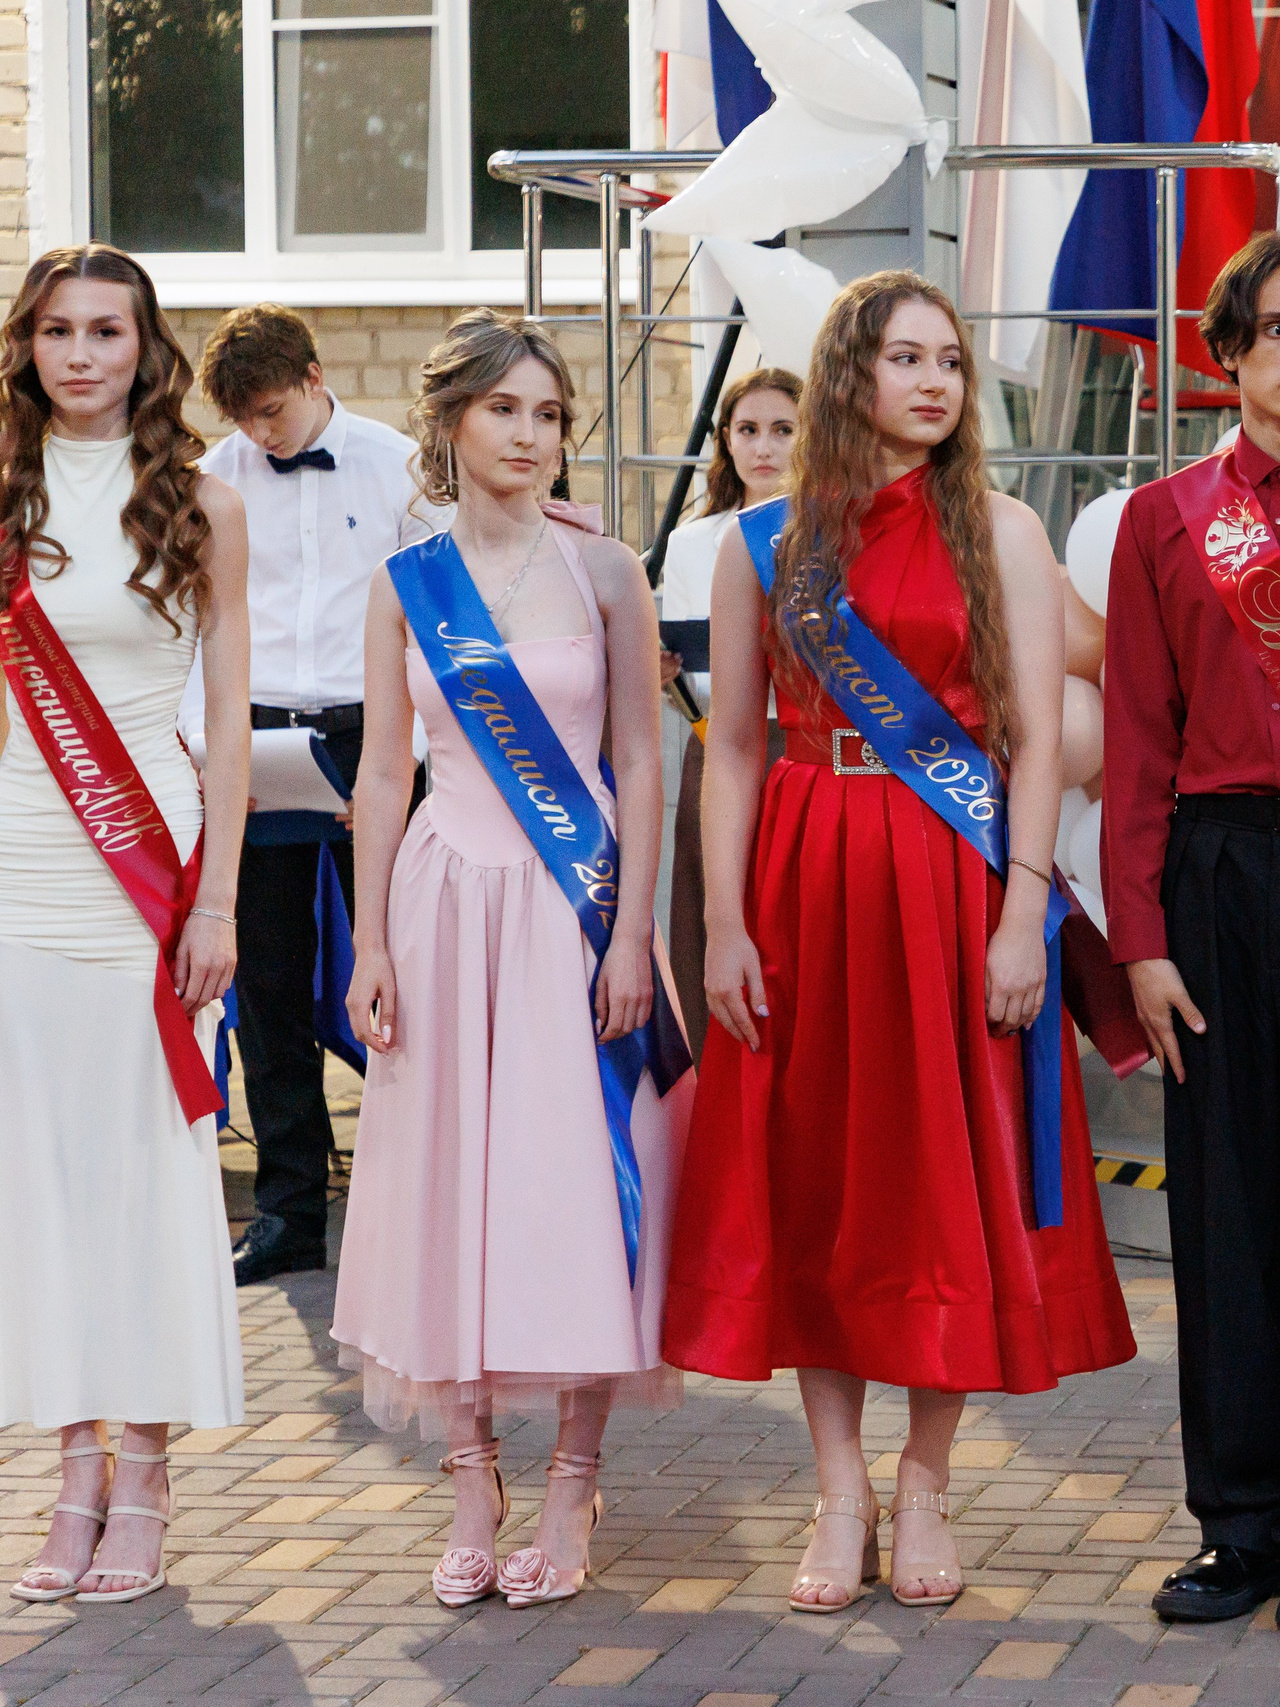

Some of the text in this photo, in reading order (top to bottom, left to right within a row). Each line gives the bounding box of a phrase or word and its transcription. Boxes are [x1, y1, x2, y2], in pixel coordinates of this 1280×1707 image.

[0, 611, 102, 783] пускница
[70, 771, 164, 853] 2026
[56, 661, 100, 730] Екатерина
[437, 621, 619, 930] Медалист 20
[905, 737, 1002, 821] 2026
